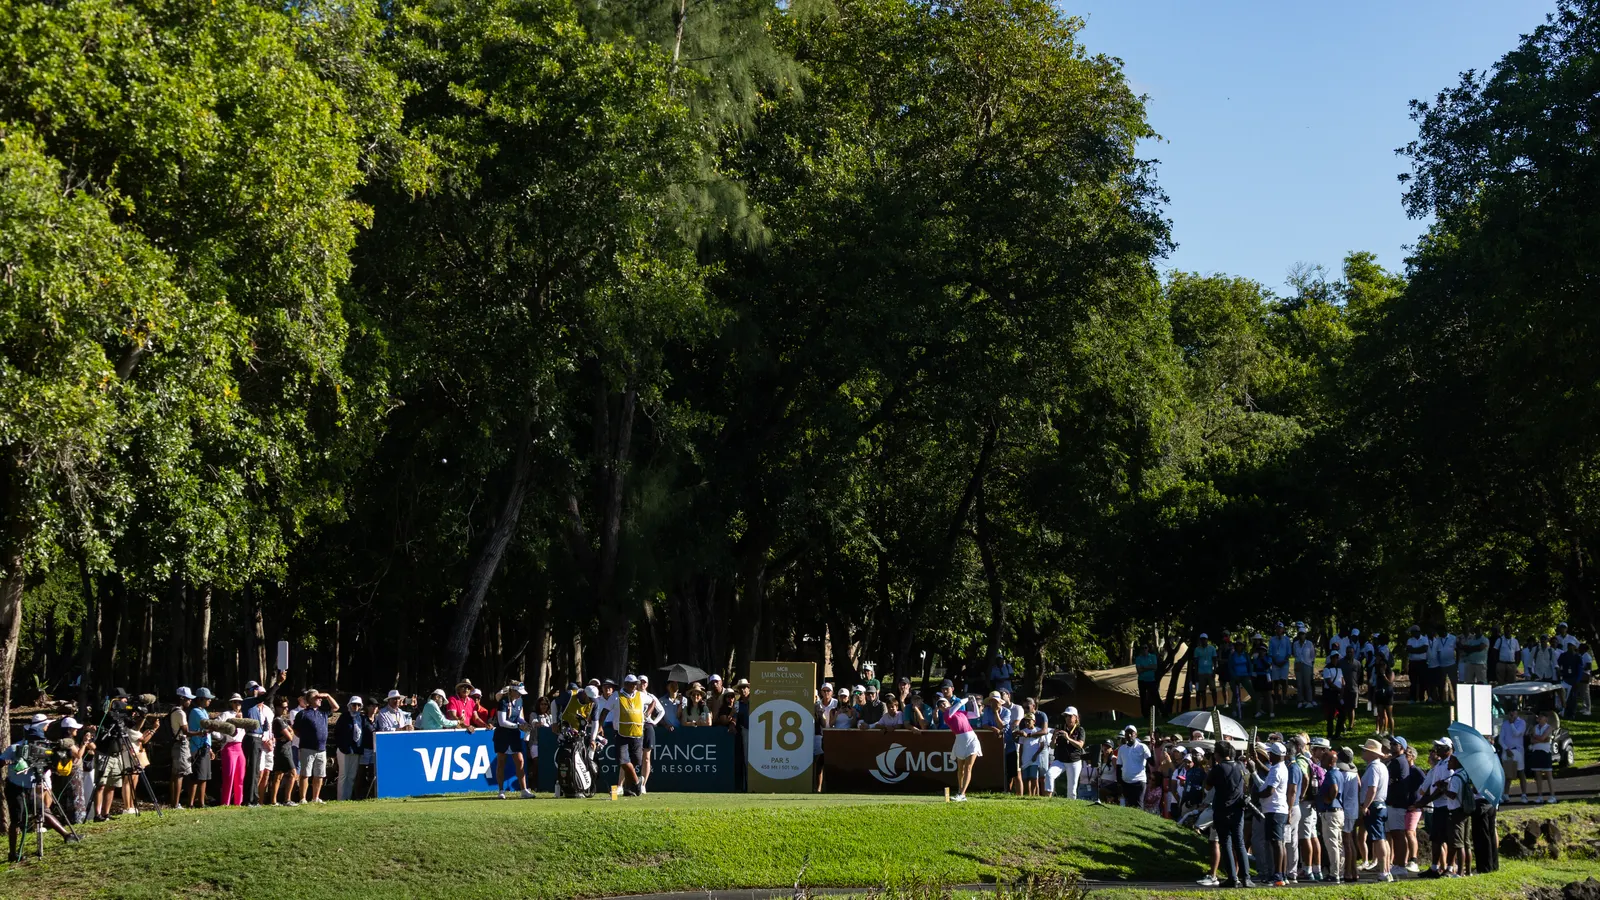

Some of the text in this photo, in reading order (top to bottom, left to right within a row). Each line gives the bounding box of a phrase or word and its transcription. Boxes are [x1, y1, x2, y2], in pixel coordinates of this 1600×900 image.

[761, 671, 781, 679] LADIES
[758, 710, 804, 751] 18
[598, 744, 717, 761] OTANCE
[905, 751, 958, 772] MCB
[413, 745, 493, 782] VISA
[661, 765, 717, 773] RESORTS
